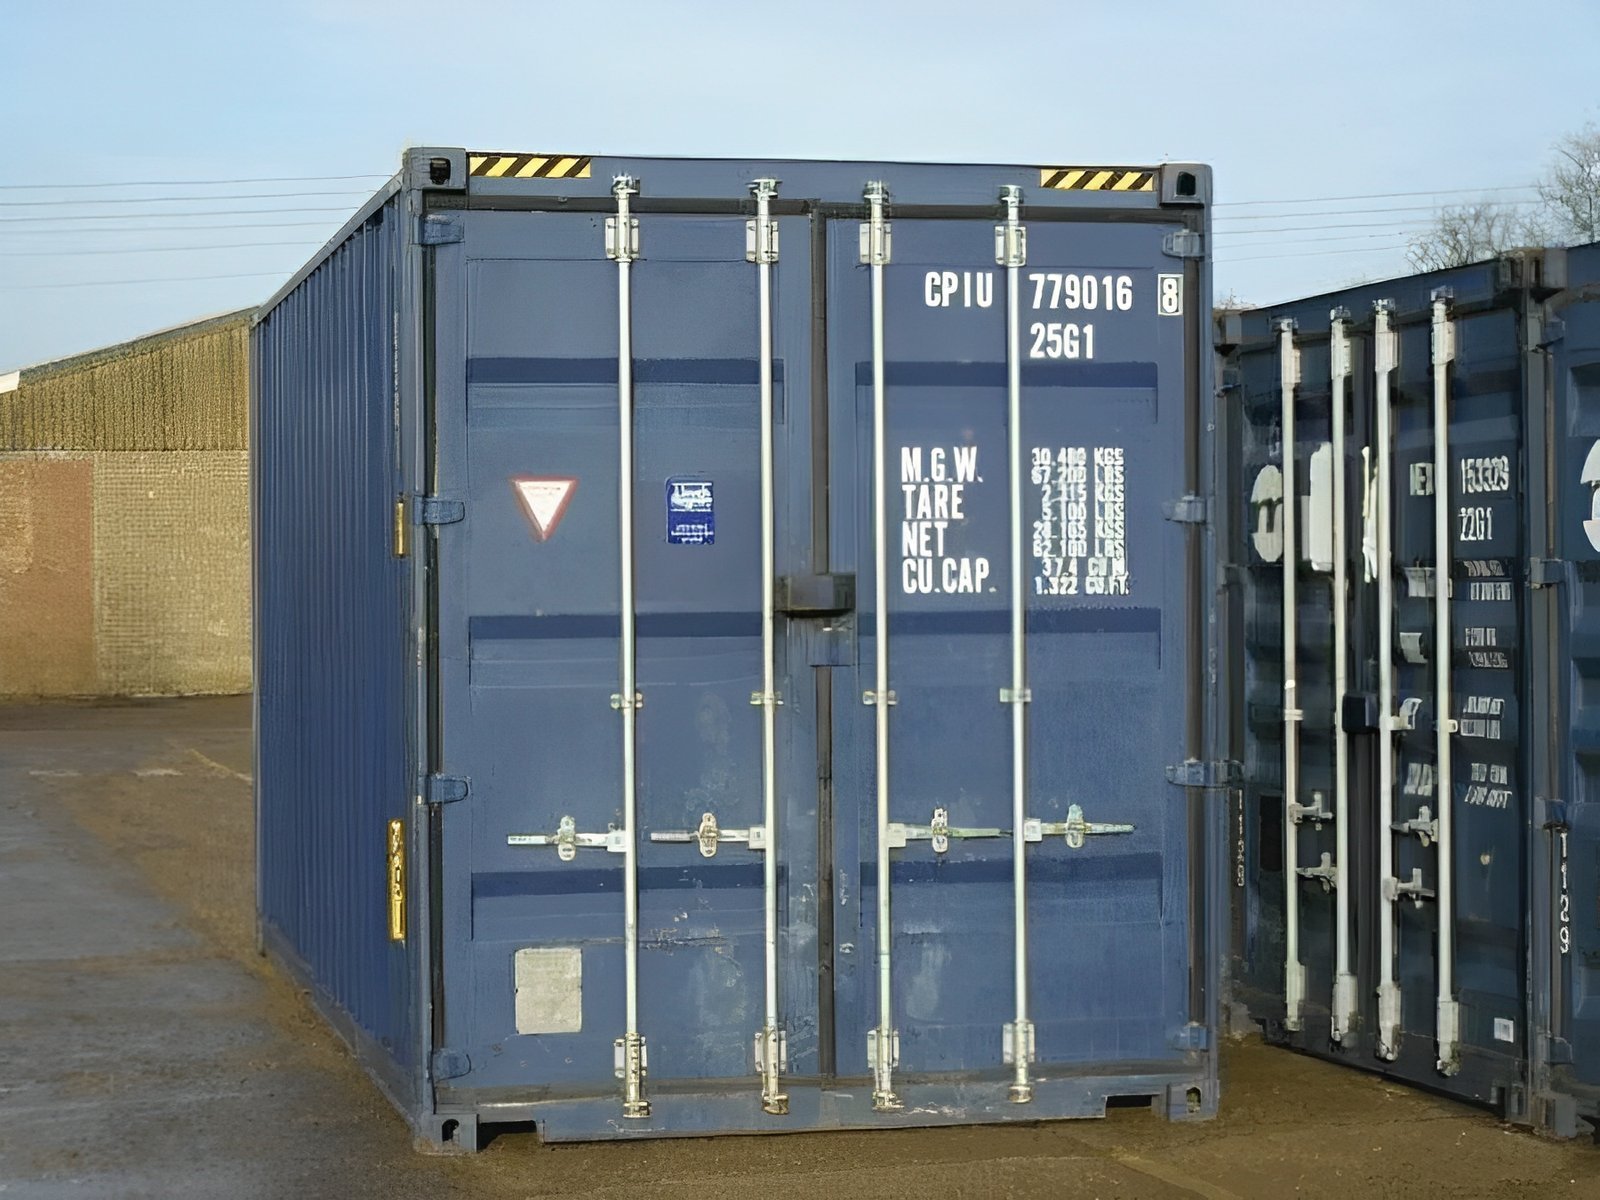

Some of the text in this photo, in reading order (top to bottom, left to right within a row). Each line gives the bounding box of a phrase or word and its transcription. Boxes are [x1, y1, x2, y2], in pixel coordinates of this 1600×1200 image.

[924, 271, 1180, 314] CPIU 779016 8
[1029, 322, 1095, 360] 25G1
[900, 445, 984, 483] M.G.W.
[1093, 466, 1124, 484] LBS
[901, 483, 965, 520] TARE
[1094, 502, 1124, 520] LBS
[901, 520, 948, 557] NET
[901, 557, 997, 594] CU.CAP.
